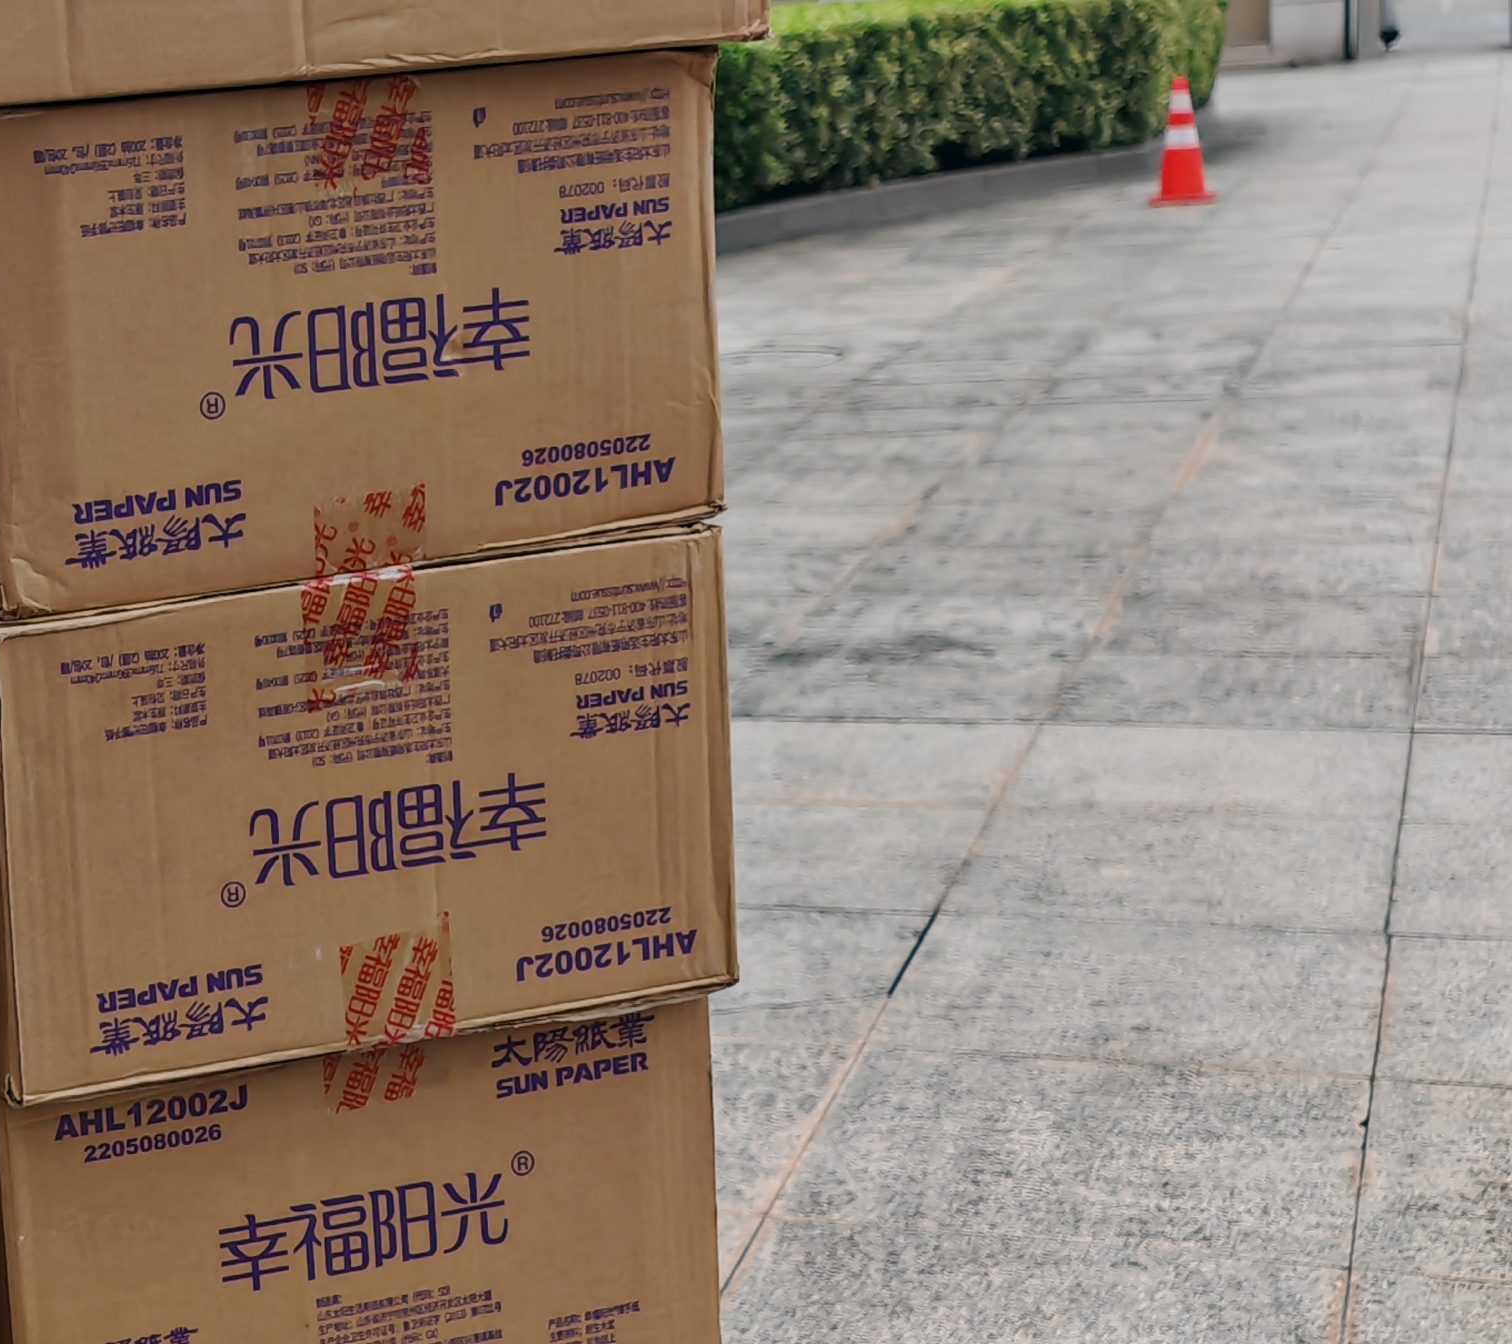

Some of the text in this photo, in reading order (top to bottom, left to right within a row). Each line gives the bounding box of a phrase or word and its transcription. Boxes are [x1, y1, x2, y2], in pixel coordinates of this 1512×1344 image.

[554, 212, 672, 254] 太陽紙業
[560, 199, 670, 222] SUN PAPER
[229, 290, 530, 400] 幸福阳光
[521, 434, 650, 466] 2205080026
[73, 480, 241, 524] SUN PAPER
[494, 460, 674, 507] AHL12002J
[66, 514, 246, 567] 太陽紙業
[570, 695, 690, 739] 太陽紙業
[576, 683, 688, 708] SUN PAPER
[249, 774, 546, 886] 幸福阳光
[541, 908, 670, 942] 2205080026
[516, 932, 696, 983] AHL12002J
[96, 964, 263, 1012] SUN PAPER
[90, 997, 268, 1054] 太陽紙業
[491, 1015, 654, 1068] 太陽紙業
[496, 1053, 648, 1099] SUN PAPER
[55, 1084, 248, 1139] AHL12002J
[84, 1125, 222, 1163] 2205080026
[220, 1173, 508, 1289] 幸福阳光
